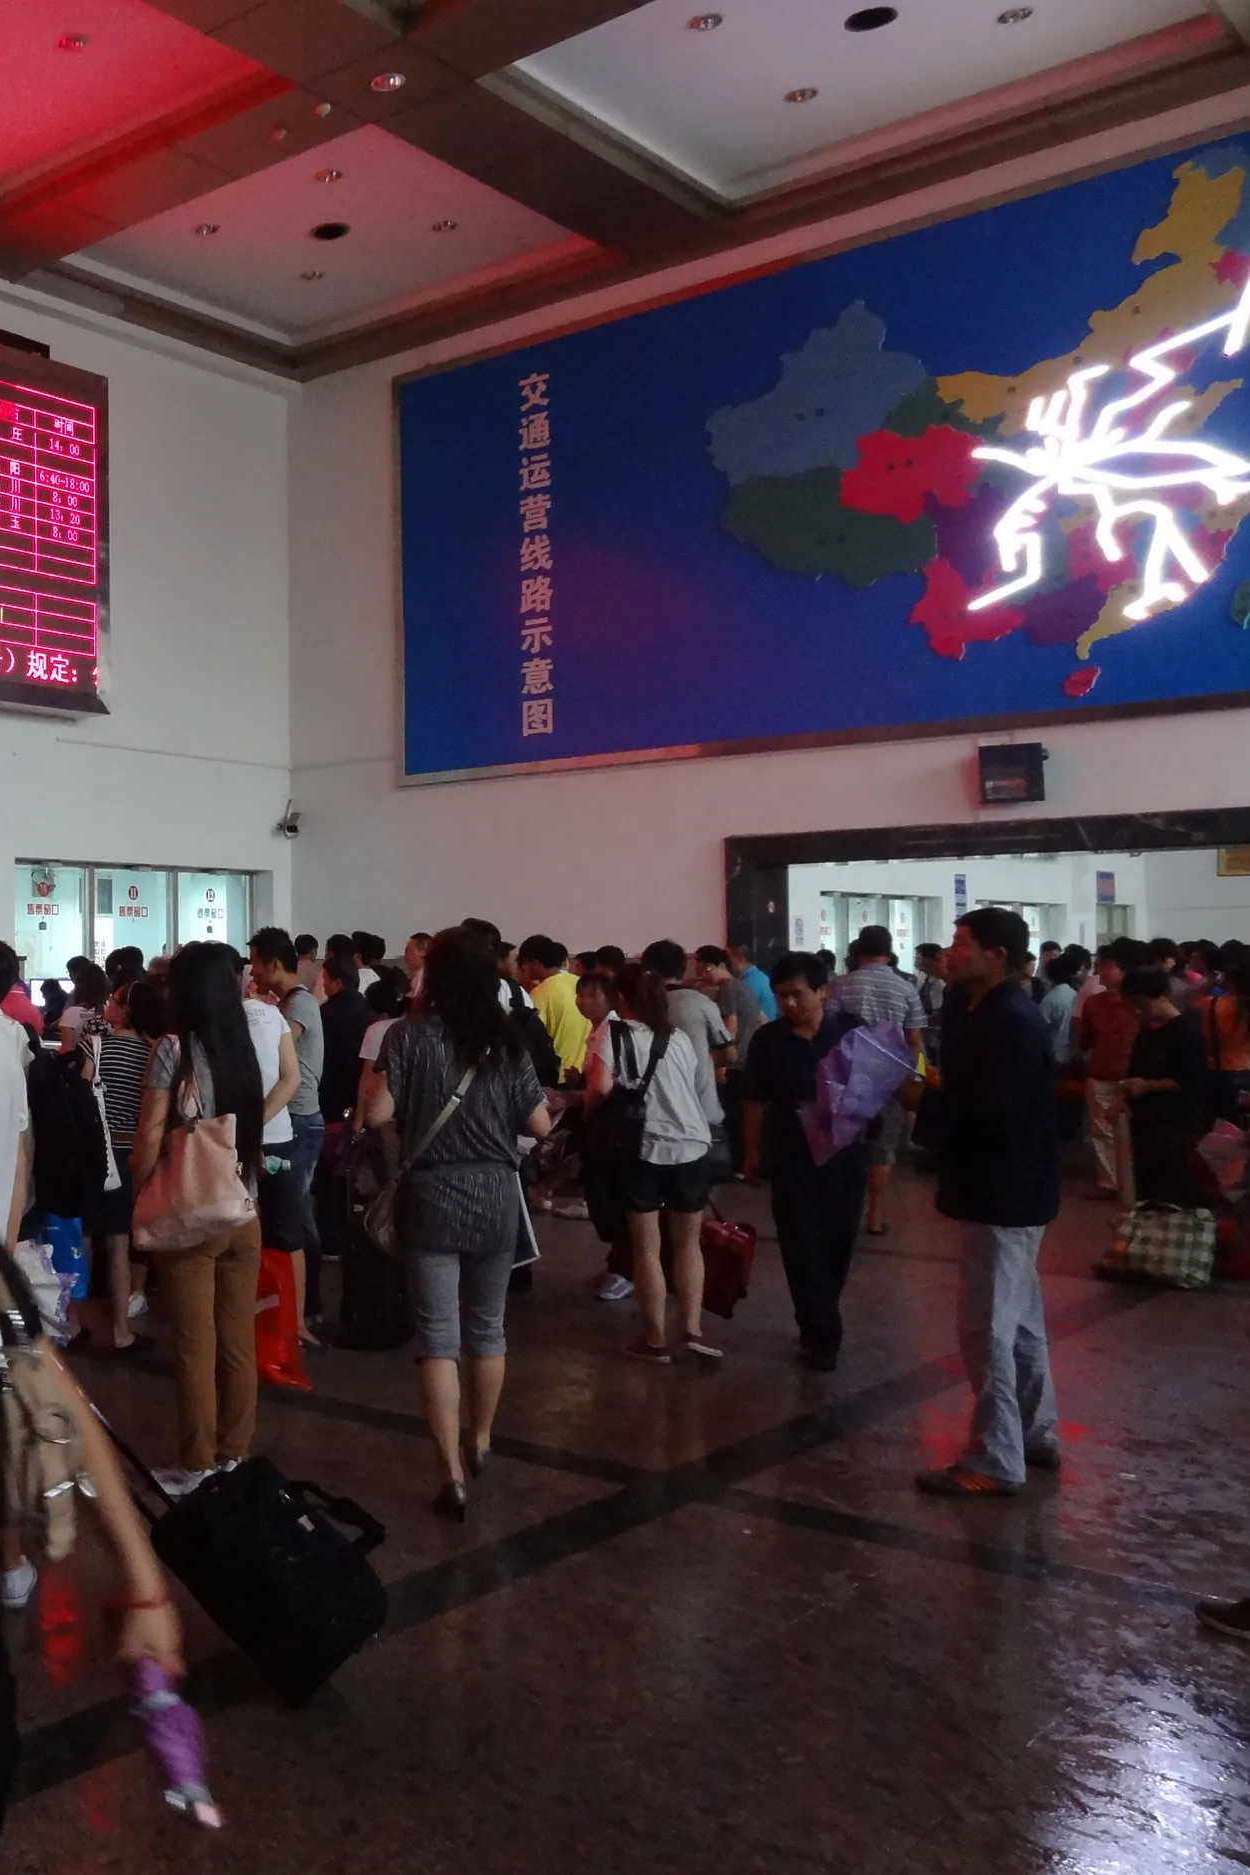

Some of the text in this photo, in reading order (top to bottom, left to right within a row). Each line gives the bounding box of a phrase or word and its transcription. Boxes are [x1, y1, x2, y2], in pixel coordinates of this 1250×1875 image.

[54, 418, 74, 436] 时间
[518, 372, 554, 738] 交通运营线路示意图
